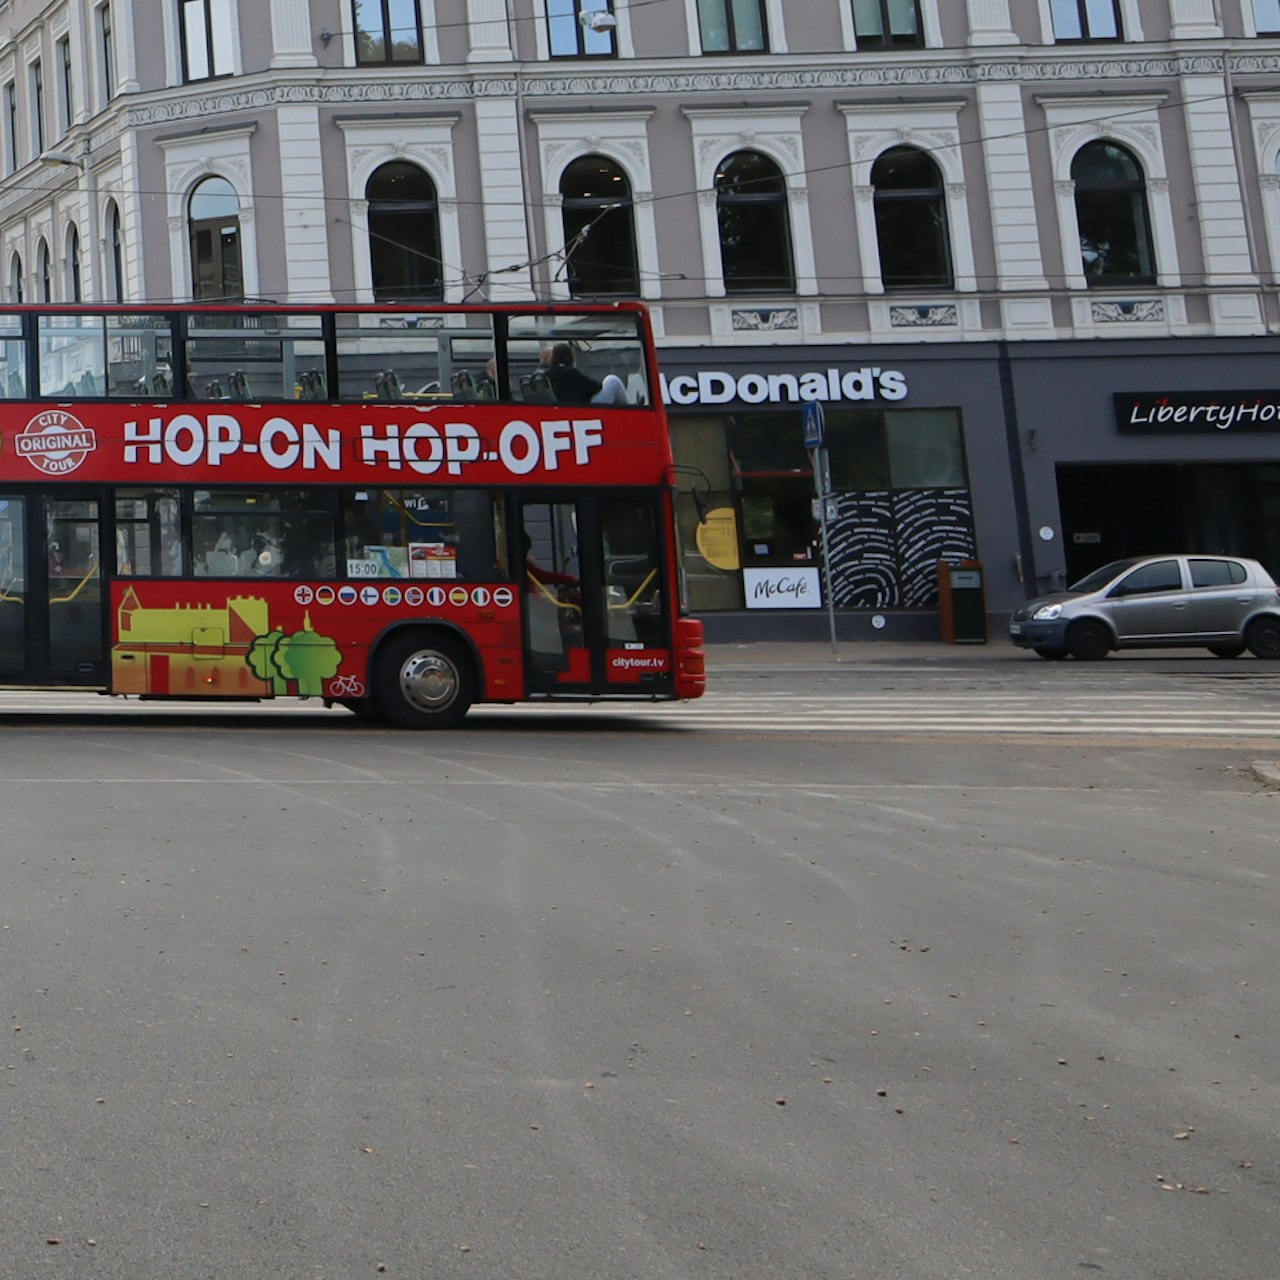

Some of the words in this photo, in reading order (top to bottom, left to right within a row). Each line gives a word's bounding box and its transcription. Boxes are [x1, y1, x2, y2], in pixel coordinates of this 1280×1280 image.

[38, 413, 68, 427] CITY
[20, 434, 91, 451] ORIGINAL
[123, 414, 341, 471] HOP-ON
[360, 419, 603, 475] HOP-OFF
[41, 457, 76, 471] TOUR
[349, 563, 377, 575] 15:00
[754, 576, 808, 599] McCafé
[612, 656, 664, 669] citytour.lv
